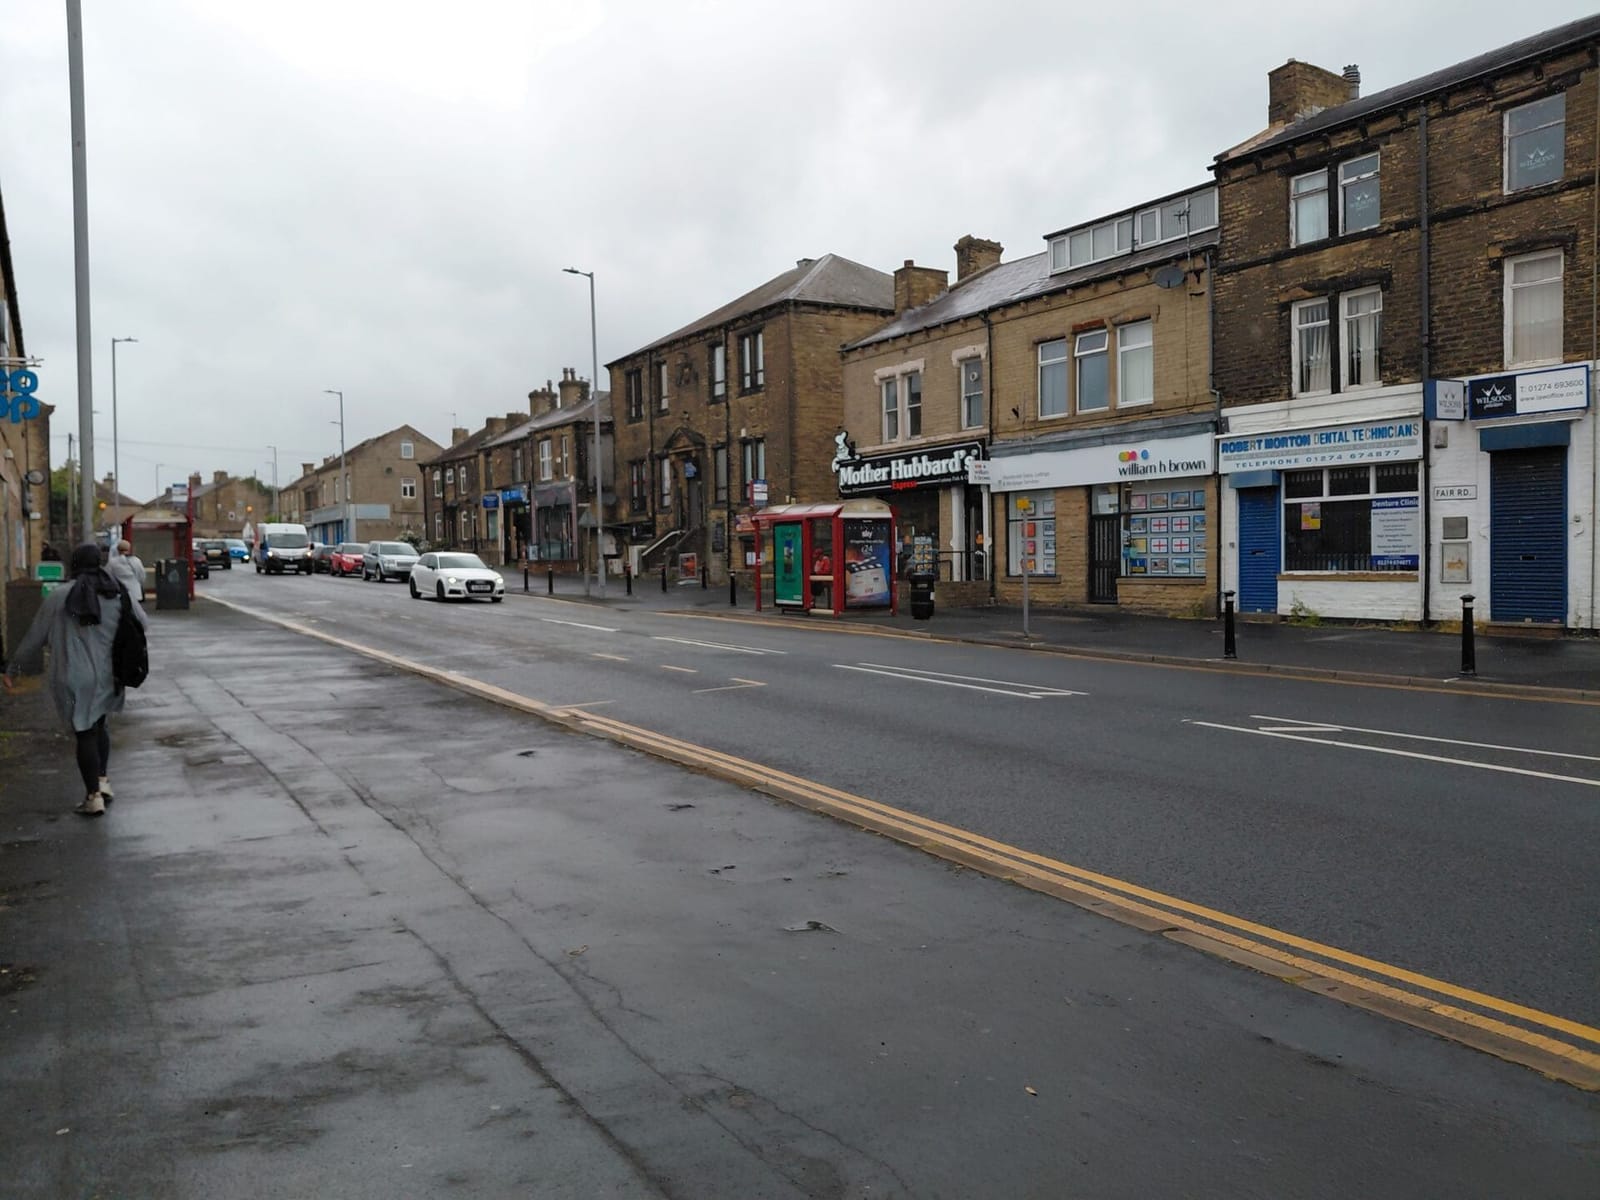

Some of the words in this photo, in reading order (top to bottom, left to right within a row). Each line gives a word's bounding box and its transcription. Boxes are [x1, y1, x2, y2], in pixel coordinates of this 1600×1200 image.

[1528, 383, 1552, 392] 01274
[1475, 393, 1512, 405] WILSONS
[1221, 439, 1263, 454] ROBERT
[1264, 434, 1311, 450] MORTON
[1313, 428, 1350, 445] DENTAL
[1352, 423, 1420, 440] TECHNICIANS
[1235, 457, 1300, 468] TELEPHONE
[1306, 454, 1343, 463] 01274
[1350, 450, 1401, 459] 674877
[839, 463, 890, 486] Mother
[890, 450, 974, 480] Hubbard's
[1118, 461, 1157, 476] william
[1159, 461, 1166, 473] h
[1168, 459, 1206, 472] brown
[1436, 489, 1454, 497] FAIR
[1457, 488, 1471, 497] RD.
[1372, 500, 1399, 508] Denture
[861, 530, 873, 539] sky
